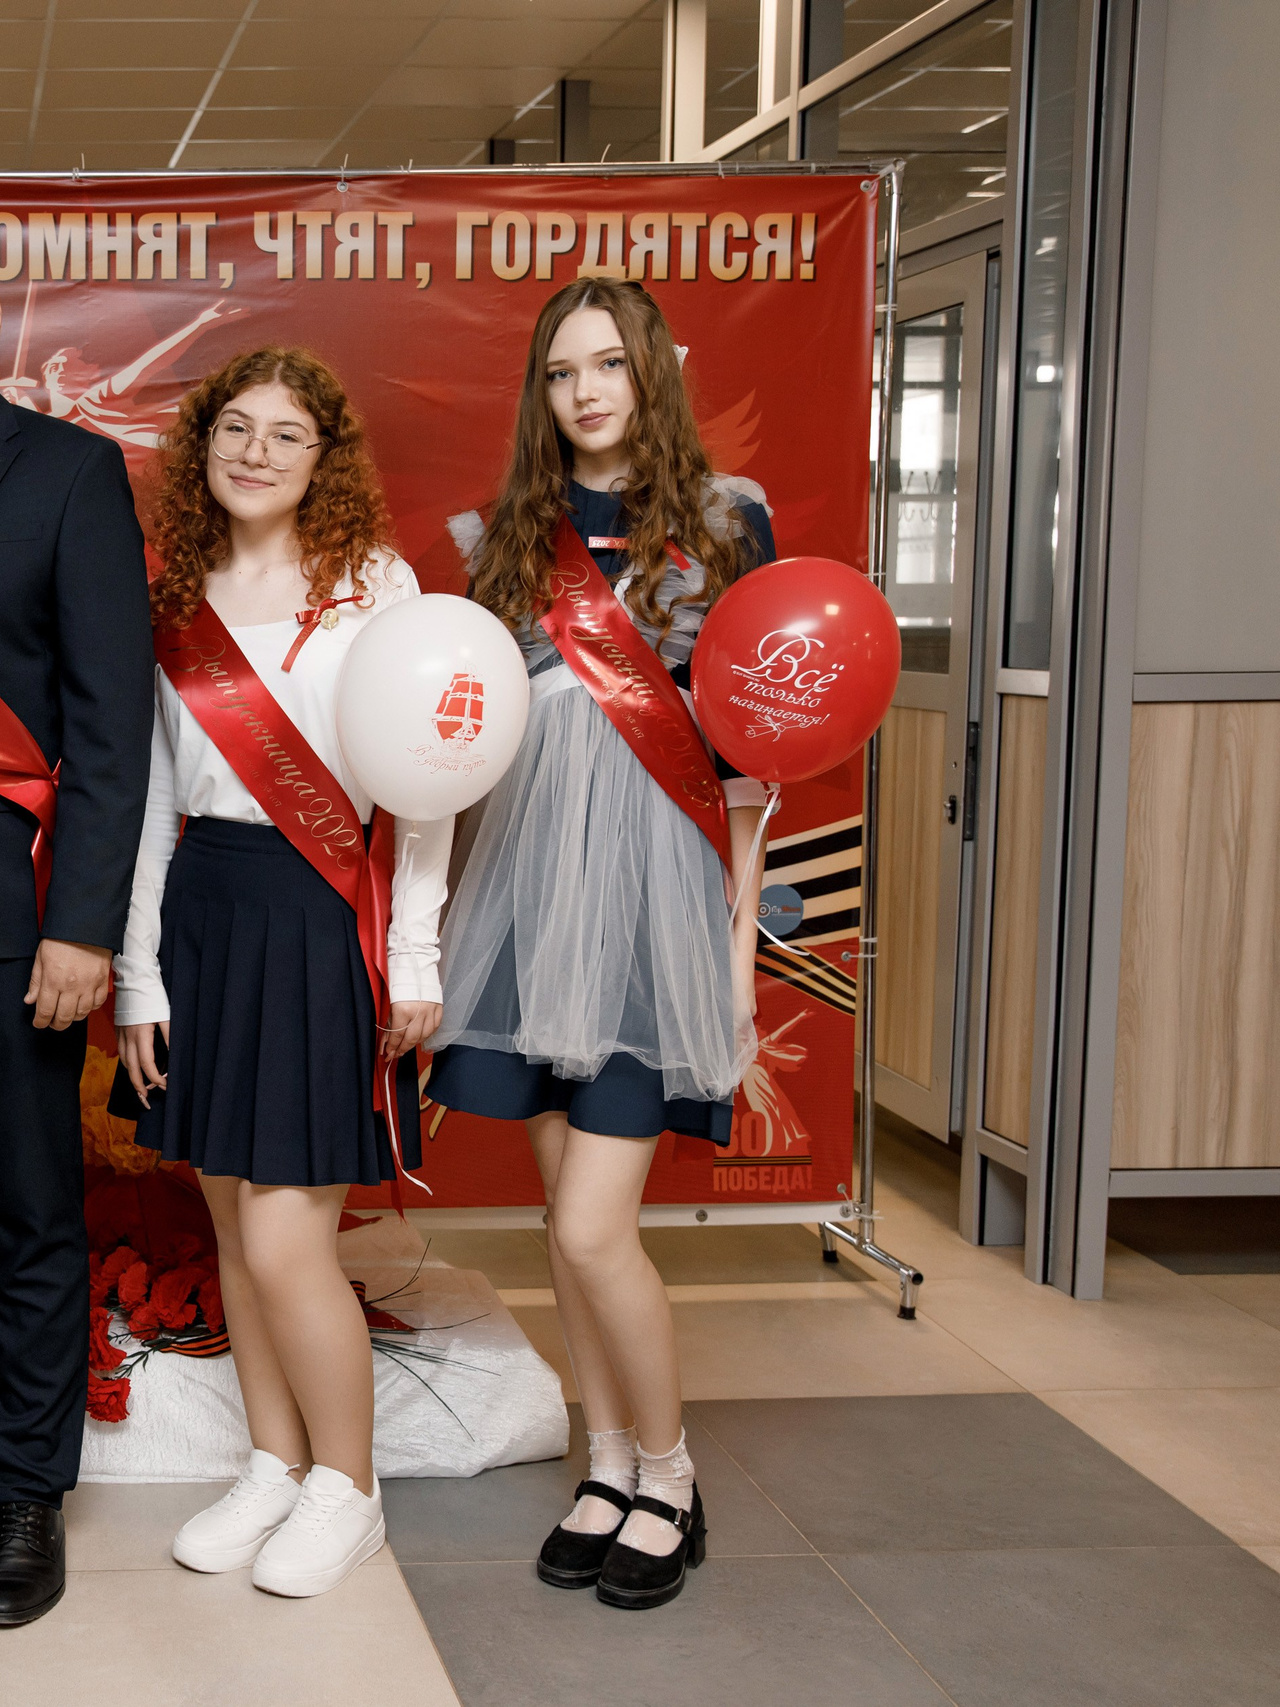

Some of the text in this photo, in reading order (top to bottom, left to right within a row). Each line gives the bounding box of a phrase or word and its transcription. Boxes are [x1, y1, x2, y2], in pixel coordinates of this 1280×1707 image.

[254, 212, 431, 289] ЧТЯТ,
[455, 212, 819, 282] ГОРДЯТСЯ!
[551, 560, 678, 732] Выпускница
[731, 629, 845, 693] Всё
[743, 680, 822, 708] только
[728, 695, 831, 728] начинается!
[631, 722, 645, 740] 107
[167, 632, 363, 871] Выпускница 2025
[462, 758, 487, 777] путь
[713, 1166, 813, 1194] ПОБЕДА!
